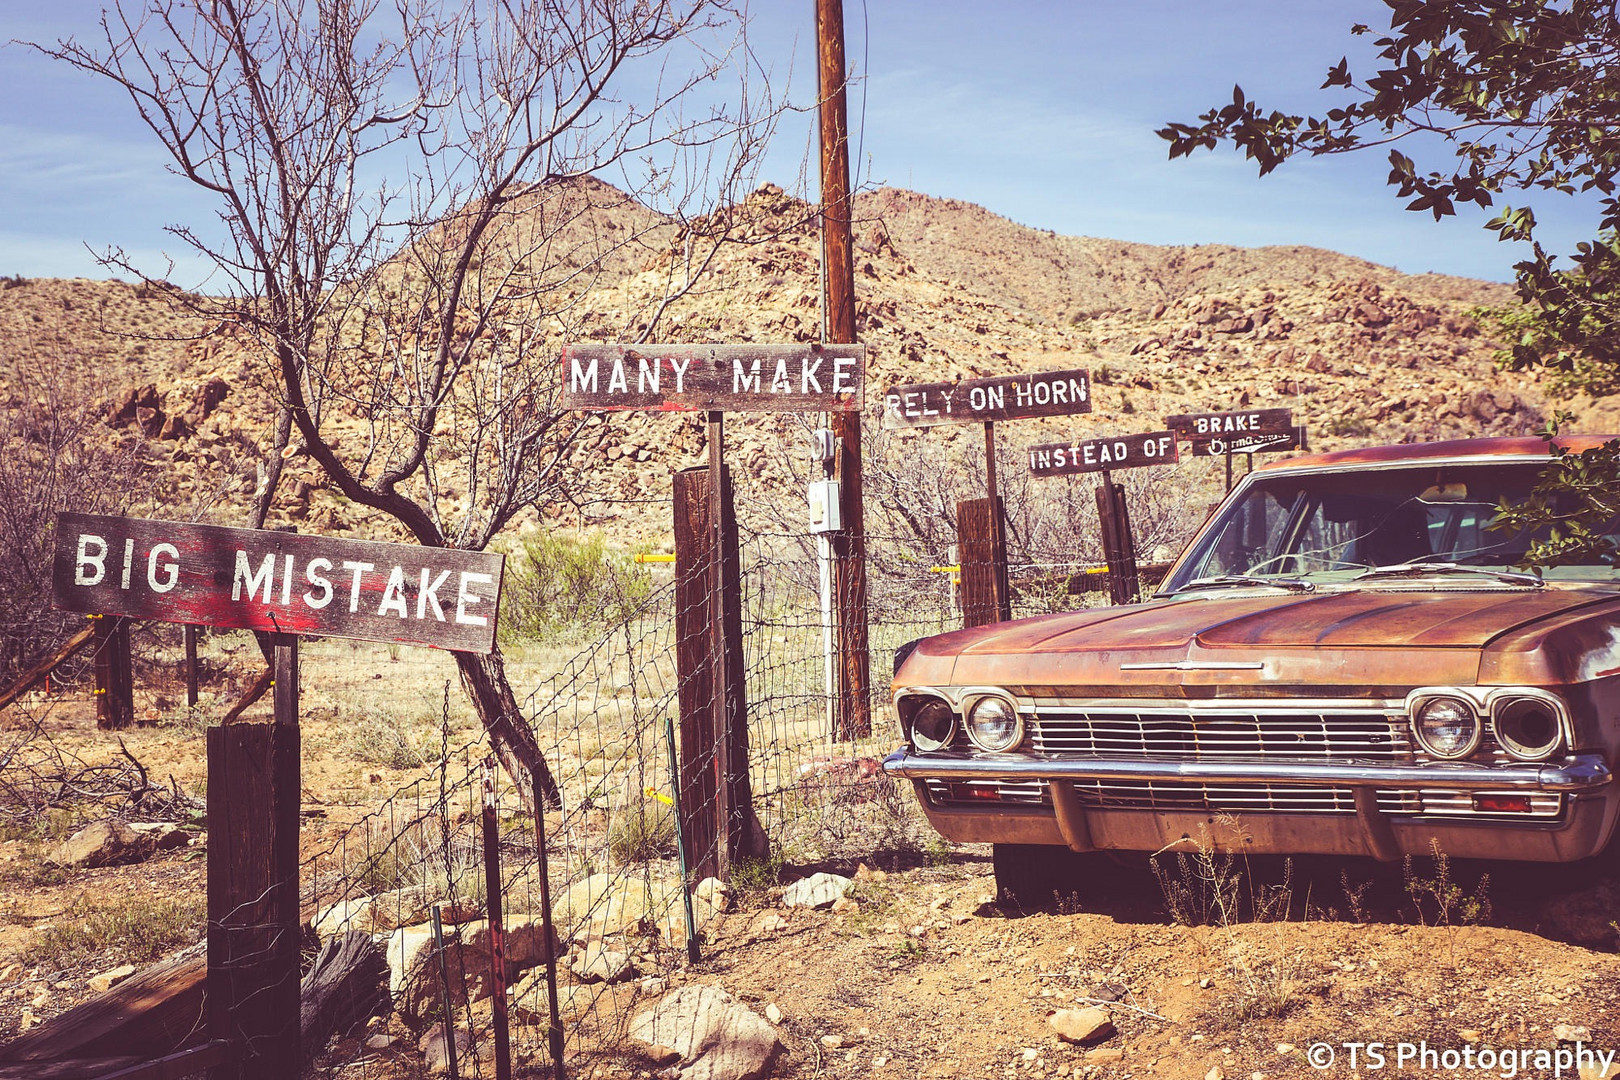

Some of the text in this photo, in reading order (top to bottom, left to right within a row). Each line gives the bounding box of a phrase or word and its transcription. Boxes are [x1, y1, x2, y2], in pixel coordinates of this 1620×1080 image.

[570, 357, 856, 394] MANY MAKE
[886, 377, 1088, 416] RELY ON HORN
[1197, 414, 1261, 434] BRAKE
[1030, 437, 1172, 470] INSTEAD OF
[75, 534, 493, 626] BIG MISTAKE
